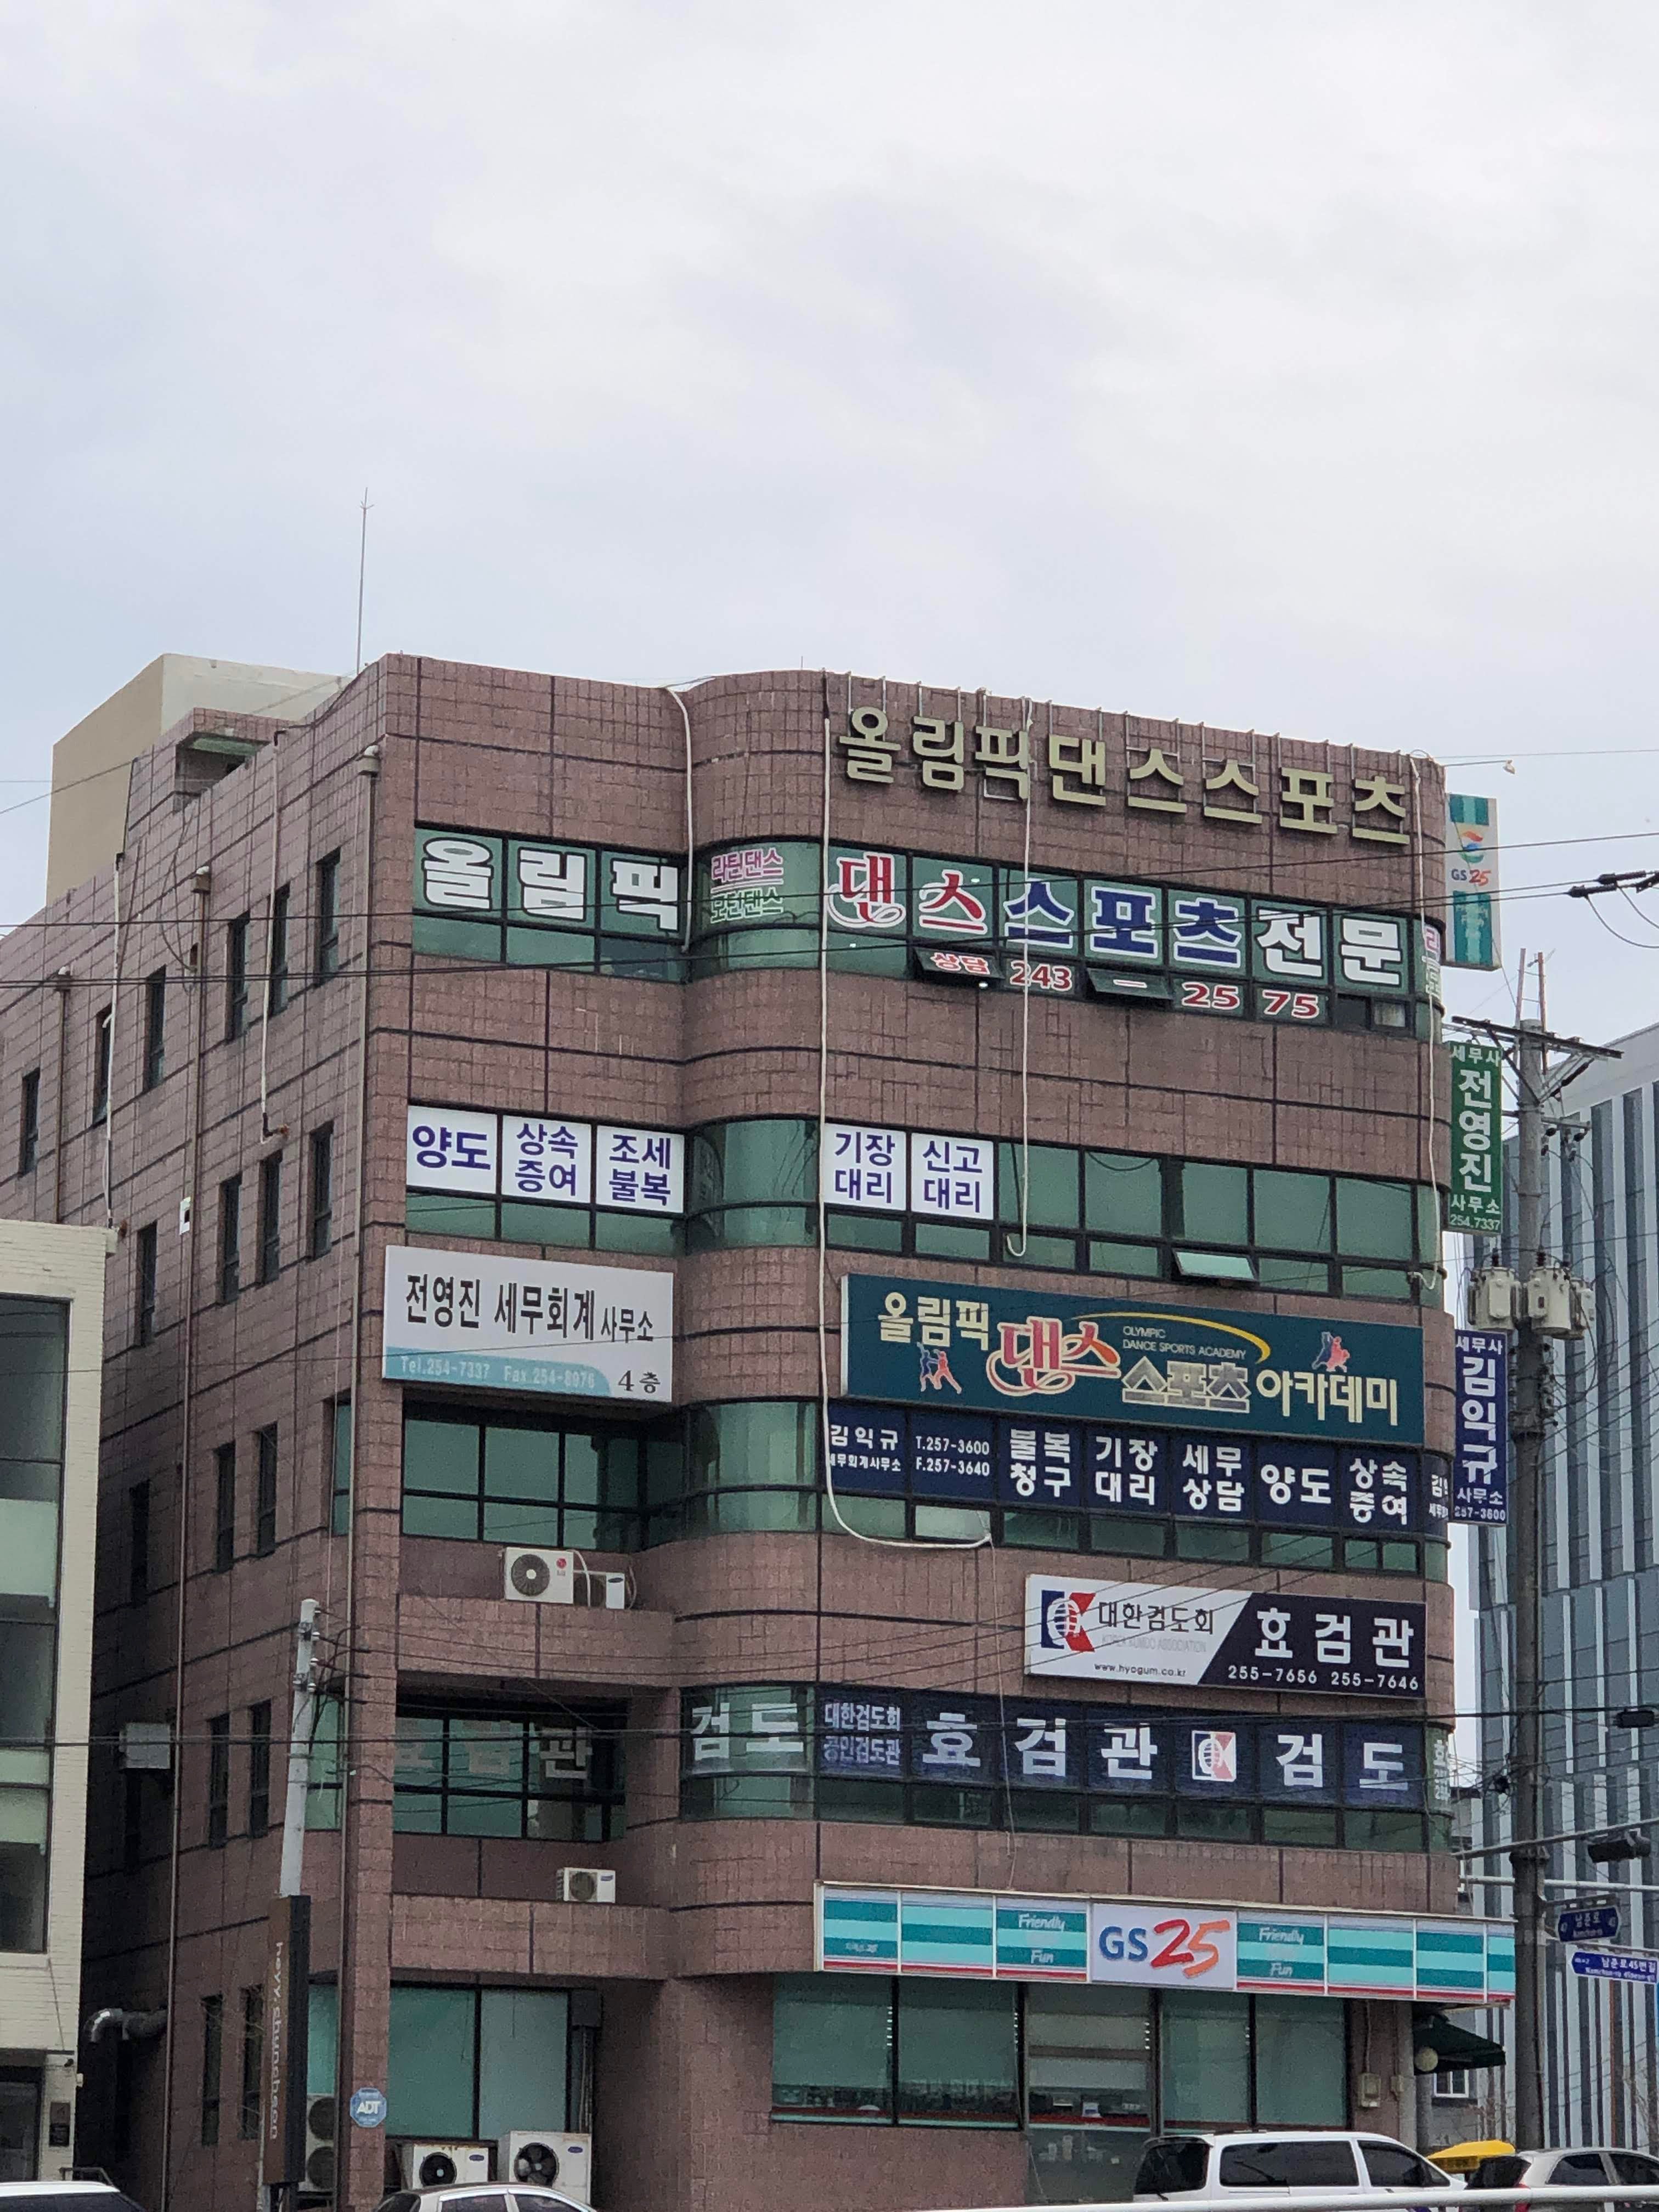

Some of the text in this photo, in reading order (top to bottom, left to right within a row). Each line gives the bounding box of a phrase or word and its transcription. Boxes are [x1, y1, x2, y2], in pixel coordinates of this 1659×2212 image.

[711, 847, 783, 883] 라틴댄스
[1451, 868, 1492, 887] GS25
[422, 837, 679, 931] 올림픽
[932, 952, 990, 975] 상담
[1451, 1045, 1501, 1067] 세무사
[412, 1125, 492, 1170] 양도
[516, 1122, 579, 1159] 상속
[1458, 1069, 1492, 1193] 전영진
[608, 1133, 671, 1169] 조세
[835, 1131, 895, 1166] 기장
[923, 1141, 983, 1173] 신고
[515, 1159, 577, 1196] 증여
[608, 1170, 671, 1206] 불복
[835, 1169, 892, 1204] 대리
[924, 1178, 980, 1213] 대리
[1451, 1194, 1501, 1215] 사무소
[406, 1273, 481, 1329] 전영진
[1122, 1325, 1166, 1339] OLYMPIC
[1456, 1335, 1503, 1355] 세무사
[878, 1291, 1398, 1426] 올림픽 댄스 스포츠 아카데미
[1122, 1339, 1246, 1360] DANCE SPORTS ACADEMY
[831, 1424, 899, 1451] 김익규
[1462, 1356, 1498, 1485] 김익규
[916, 1435, 990, 1455] T.257-3600
[1010, 1429, 1070, 1464] 불복
[1096, 1436, 1158, 1471] 기장
[1182, 1444, 1243, 1477] 세무
[916, 1457, 990, 1476] F.257-3640
[1010, 1463, 1071, 1497] 청구
[1350, 1458, 1407, 1492] 상속
[1096, 1471, 1155, 1505] 대리
[1182, 1478, 1245, 1512] 상담
[1261, 1464, 1331, 1505] 양도
[1457, 1487, 1503, 1505] 사무소
[1350, 1491, 1407, 1525] 증여
[1098, 1600, 1215, 1635] 대한검도회
[1228, 1665, 1419, 1690] 255-7656 255-7646
[690, 1702, 804, 1760] 검도
[825, 1702, 900, 1731] 대한검도회
[1018, 1913, 1066, 1931] Friendly
[1259, 1927, 1304, 1945] Friendly
[1030, 1949, 1054, 1963] Fun
[1098, 1918, 1230, 1979] GS25
[1269, 1962, 1293, 1976] Fun
[356, 2100, 381, 2114] ADT
